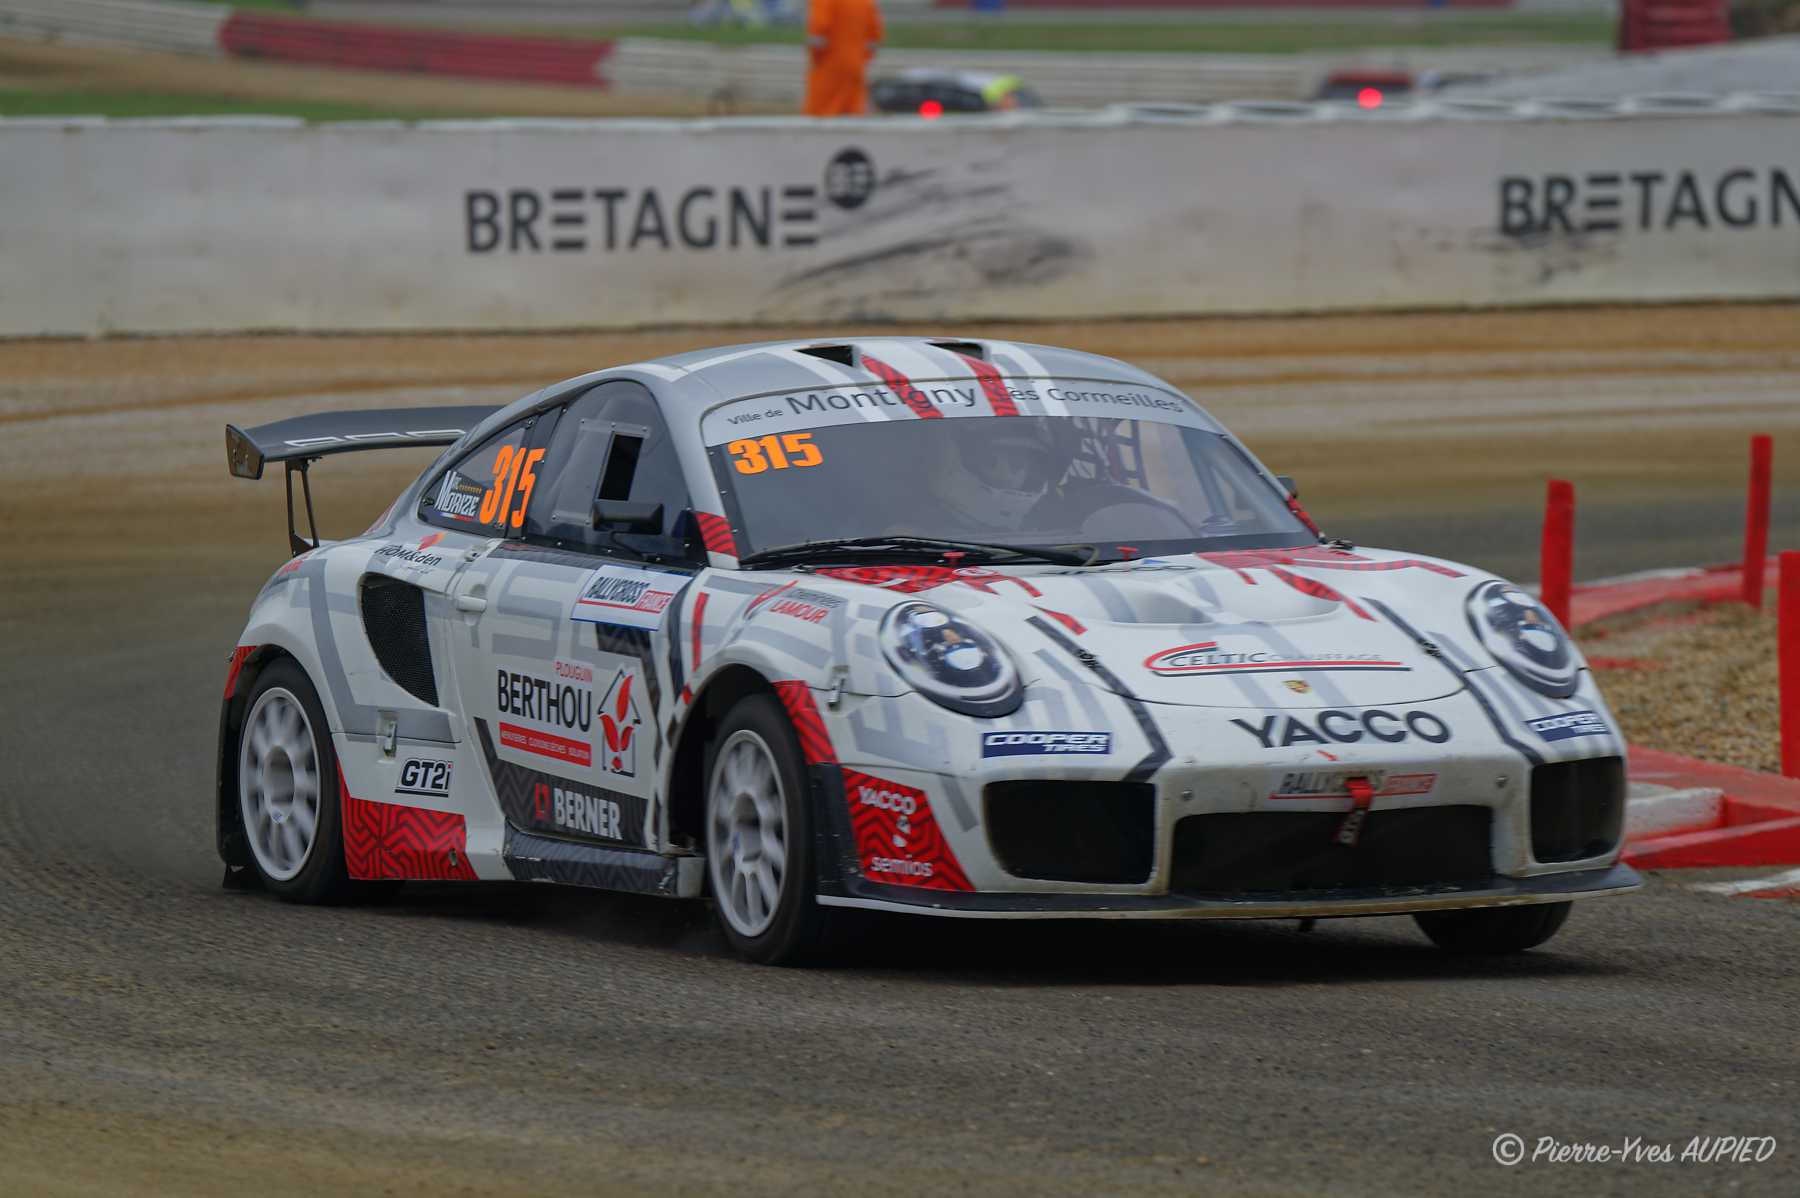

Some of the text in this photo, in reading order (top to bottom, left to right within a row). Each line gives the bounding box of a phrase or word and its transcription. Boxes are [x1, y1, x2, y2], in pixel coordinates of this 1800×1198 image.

[465, 186, 818, 253] BRETAGNE
[727, 410, 761, 425] Ville
[765, 408, 784, 419] de
[786, 386, 976, 414] Montigny
[1047, 386, 1184, 413] Cormeilles
[727, 432, 824, 475] 315
[479, 445, 546, 529] 315
[1169, 652, 1268, 668] CELTIC
[497, 668, 592, 732] BERTHOU
[984, 733, 1110, 746] COOPER
[1228, 709, 1451, 748] YACCO
[1528, 713, 1600, 732] COOPER
[1043, 744, 1106, 752] TIRES
[553, 787, 623, 841] BERNER
[858, 785, 917, 815] YACCO
[870, 853, 934, 877] semios
